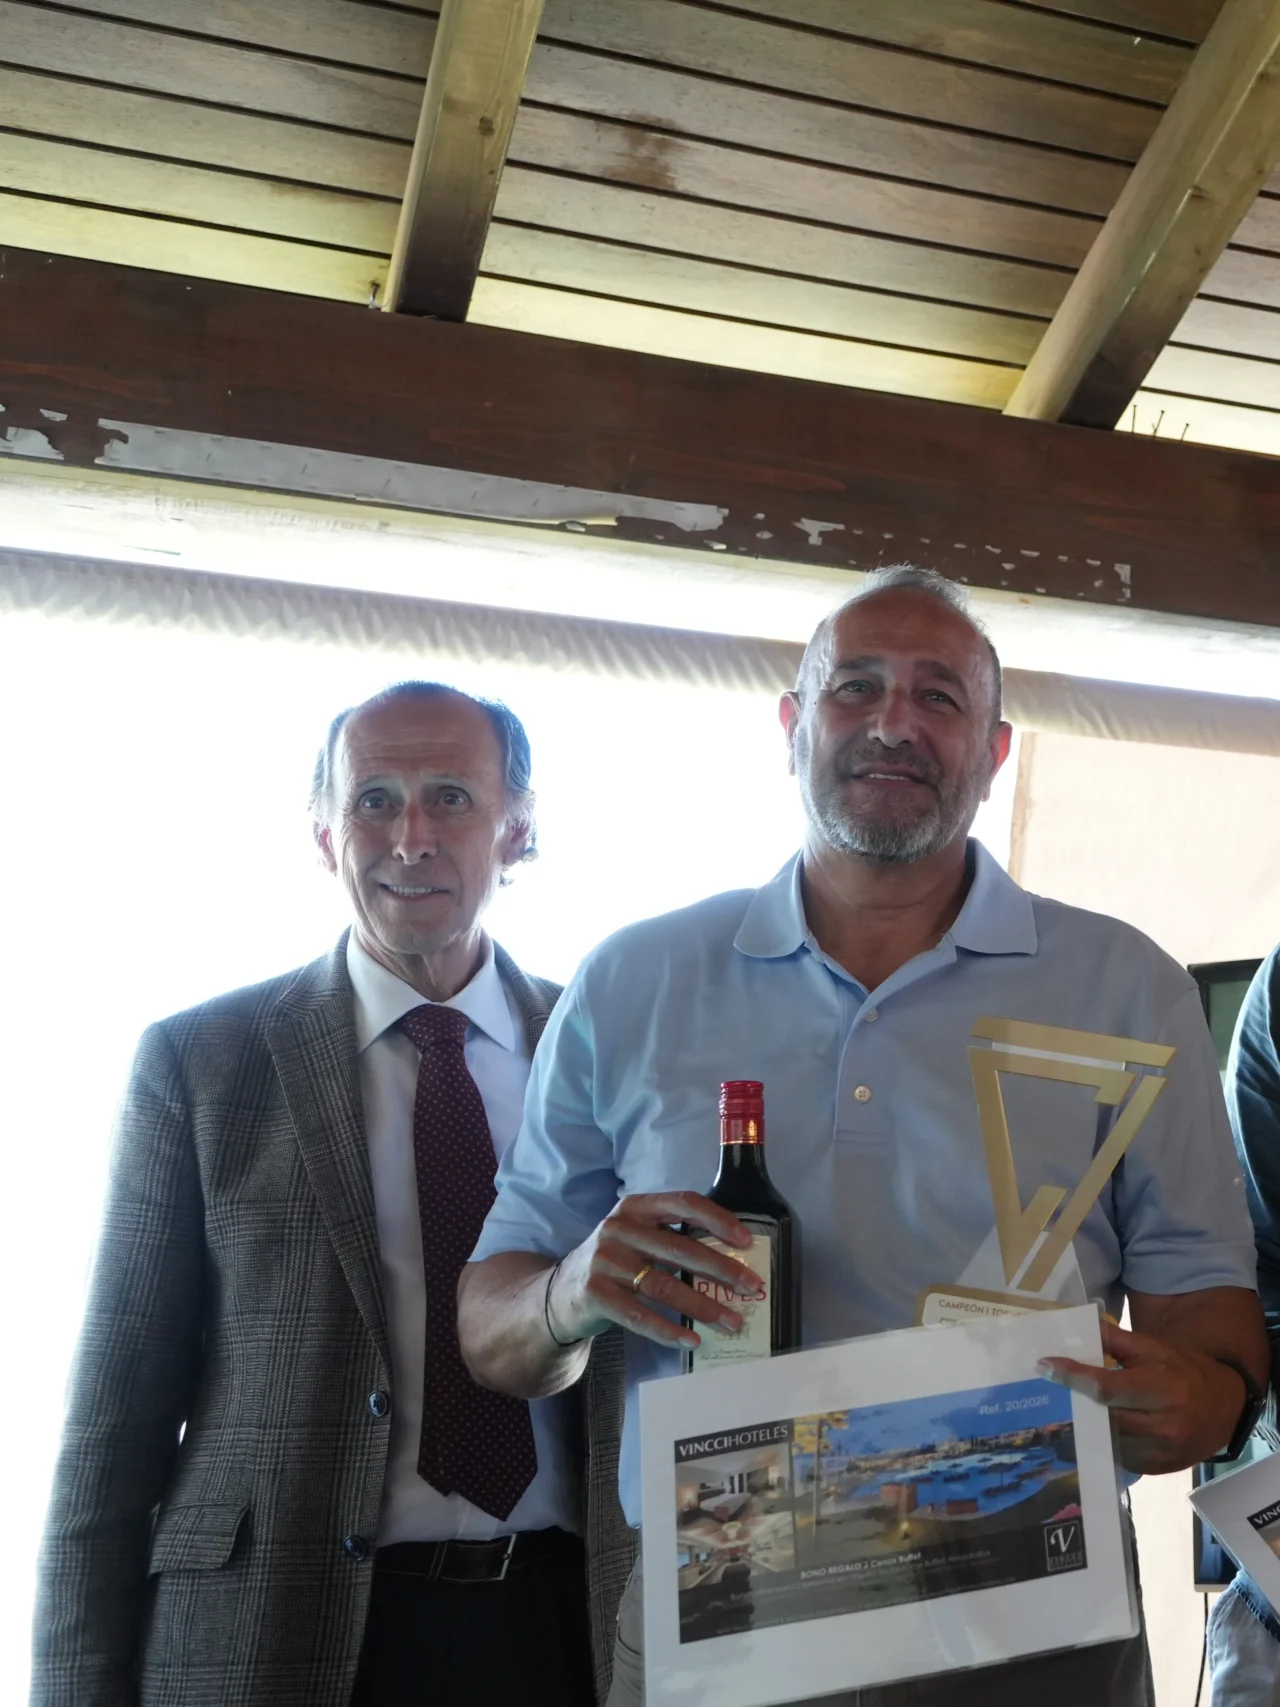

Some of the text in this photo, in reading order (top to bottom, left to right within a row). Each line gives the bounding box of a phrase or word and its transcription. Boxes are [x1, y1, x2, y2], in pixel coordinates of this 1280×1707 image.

[678, 1425, 789, 1457] VINCCIHOTELES
[801, 1568, 826, 1579] BONO
[828, 1563, 861, 1574] REGALO
